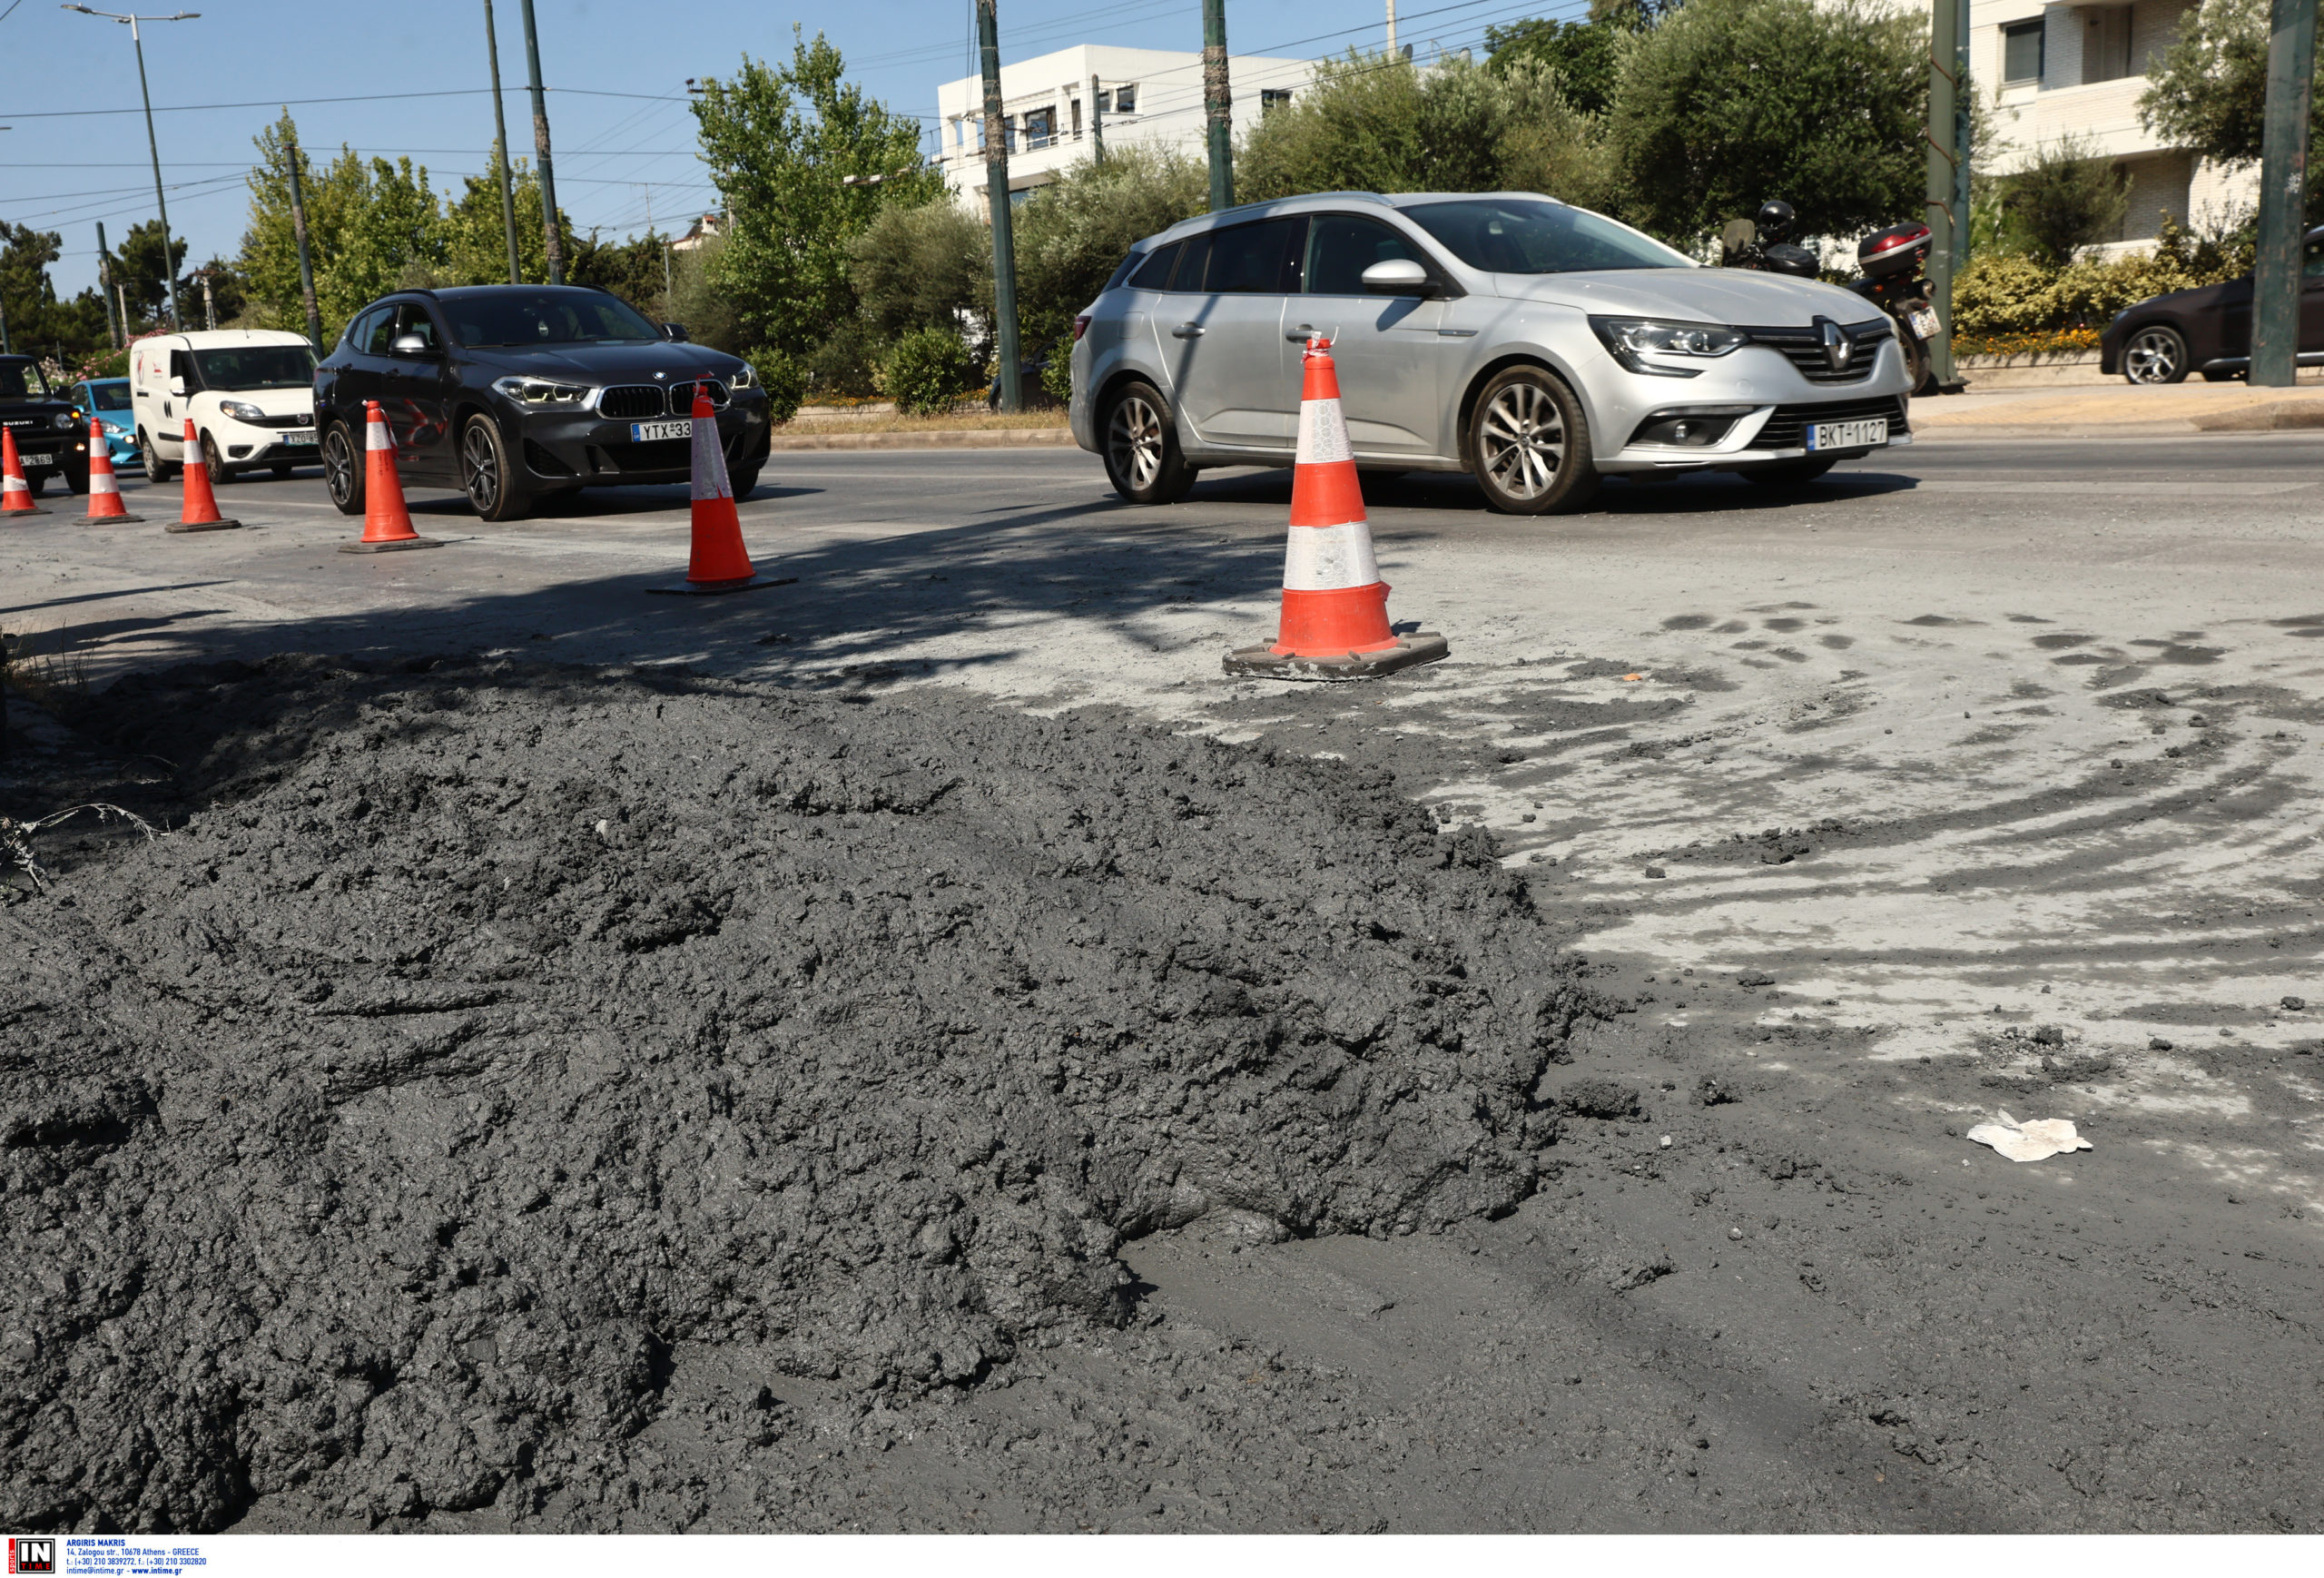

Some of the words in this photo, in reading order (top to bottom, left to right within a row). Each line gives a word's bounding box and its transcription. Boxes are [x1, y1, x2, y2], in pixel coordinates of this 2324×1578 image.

[644, 422, 691, 439] YTX-33
[1819, 420, 1885, 447] BKT-1127
[20, 455, 51, 465] A-2869
